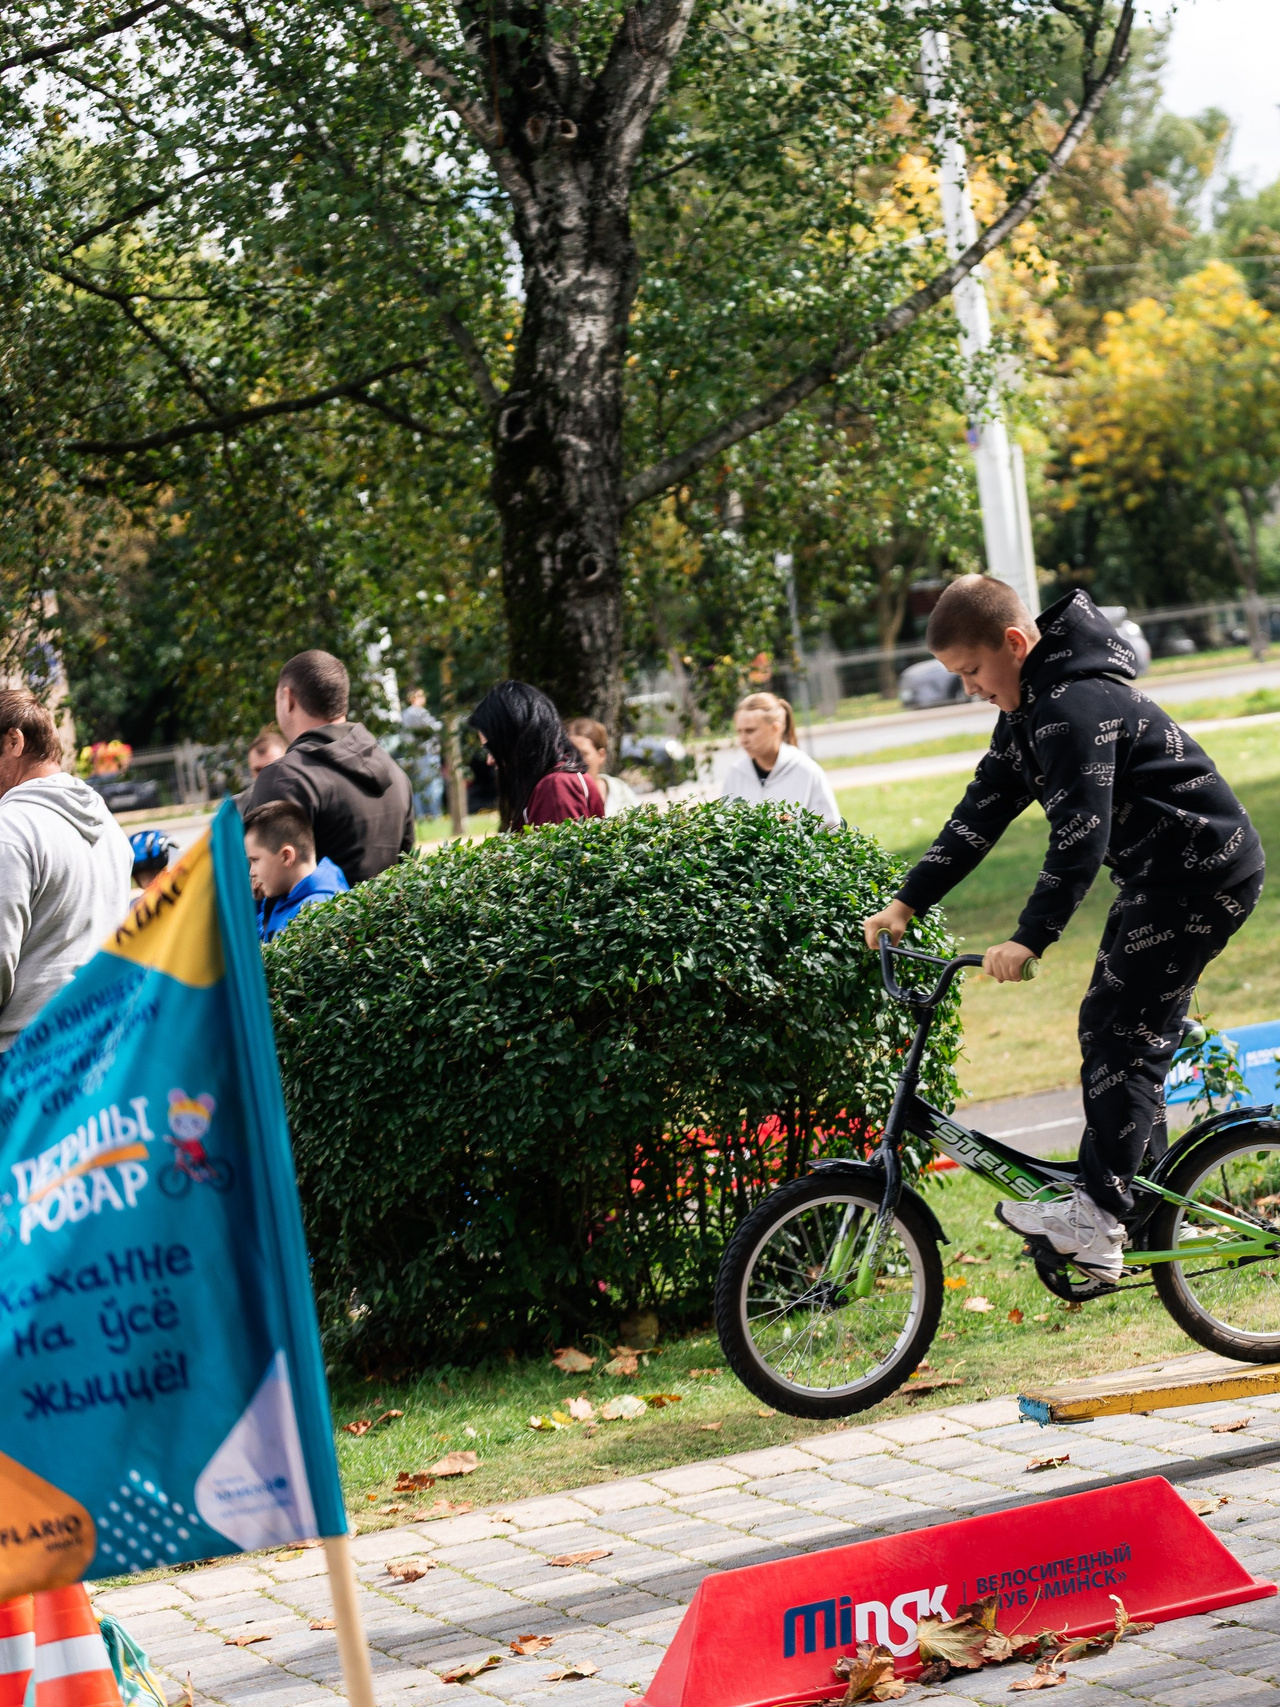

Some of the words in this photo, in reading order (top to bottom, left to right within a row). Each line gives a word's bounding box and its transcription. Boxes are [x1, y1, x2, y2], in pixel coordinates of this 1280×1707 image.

[1099, 718, 1124, 732] STAY
[1164, 729, 1175, 755] STAY
[949, 819, 994, 851] CRAZY
[1057, 813, 1084, 838] STAY
[1058, 814, 1101, 851] CURIOUS
[1124, 929, 1176, 954] CURIOUS
[1127, 923, 1154, 941] STAY
[1184, 924, 1213, 935] IOUS
[1089, 1069, 1129, 1100] CURIOUS
[1090, 1063, 1110, 1085] STAY
[935, 1121, 1041, 1199] STELS
[20, 1159, 149, 1245] РОВАР
[976, 1541, 1132, 1595] ВЕЛОСИПЕДНЫЙ
[1033, 1567, 1128, 1600] «МИНСК»
